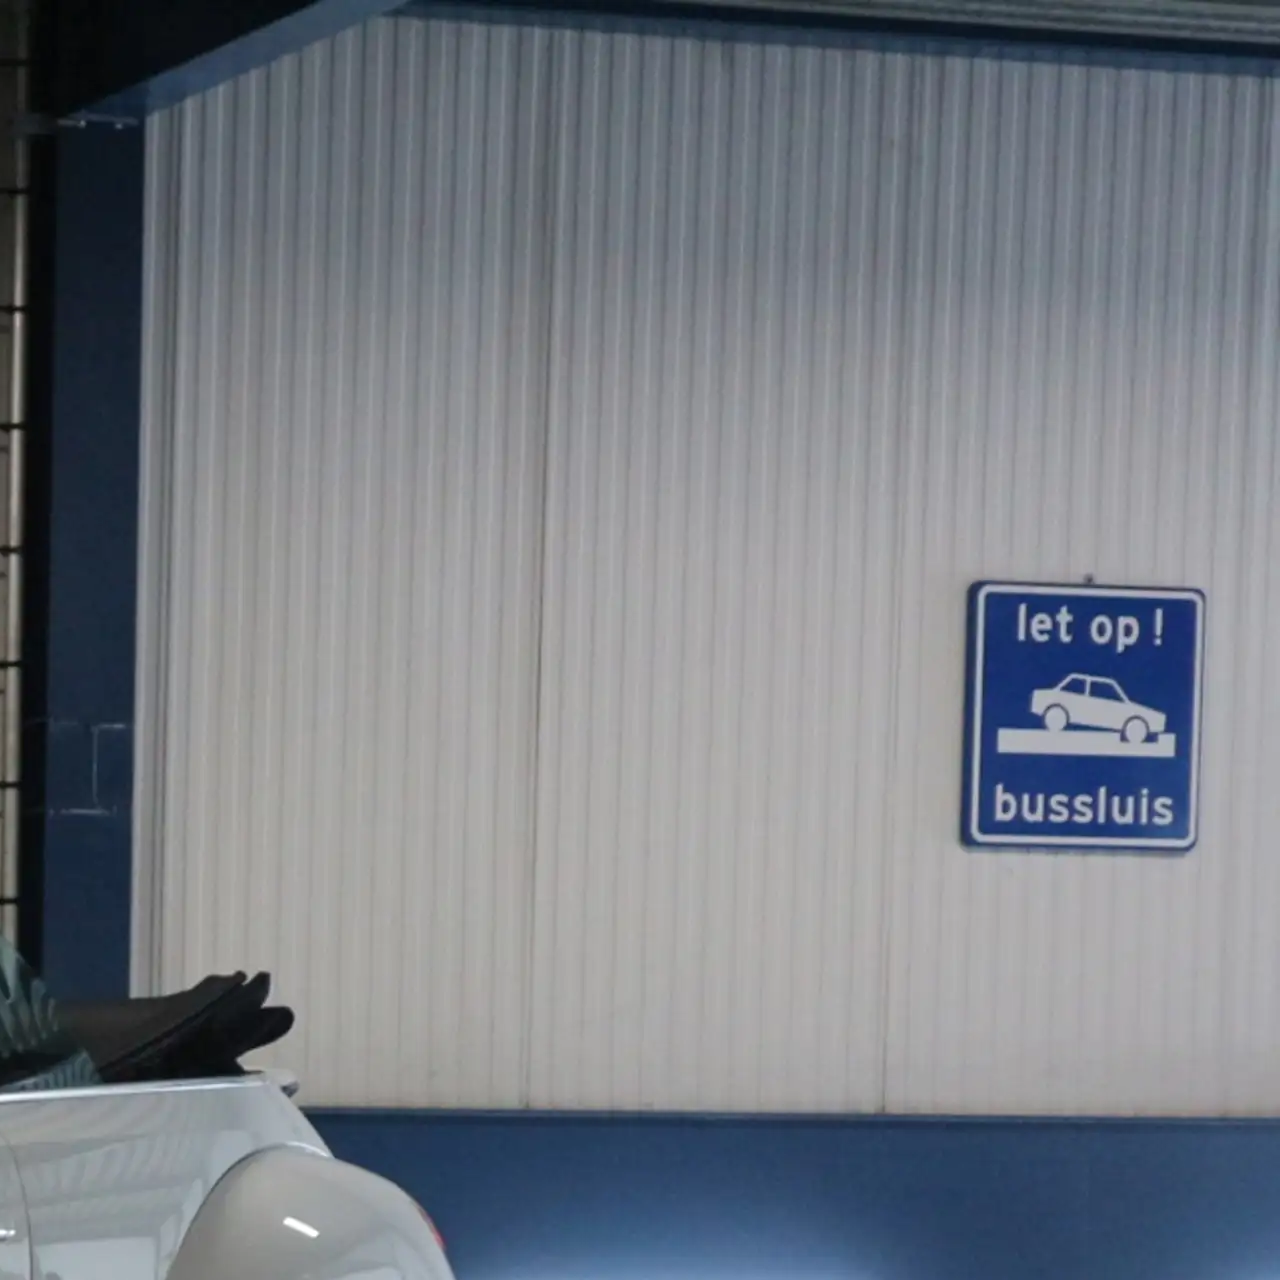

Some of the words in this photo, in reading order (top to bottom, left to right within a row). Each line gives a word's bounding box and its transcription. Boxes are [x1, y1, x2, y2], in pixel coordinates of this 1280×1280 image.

[1017, 603, 1073, 643] let
[1090, 613, 1140, 653] op
[1153, 608, 1163, 646] !
[994, 783, 1174, 826] bussluis
